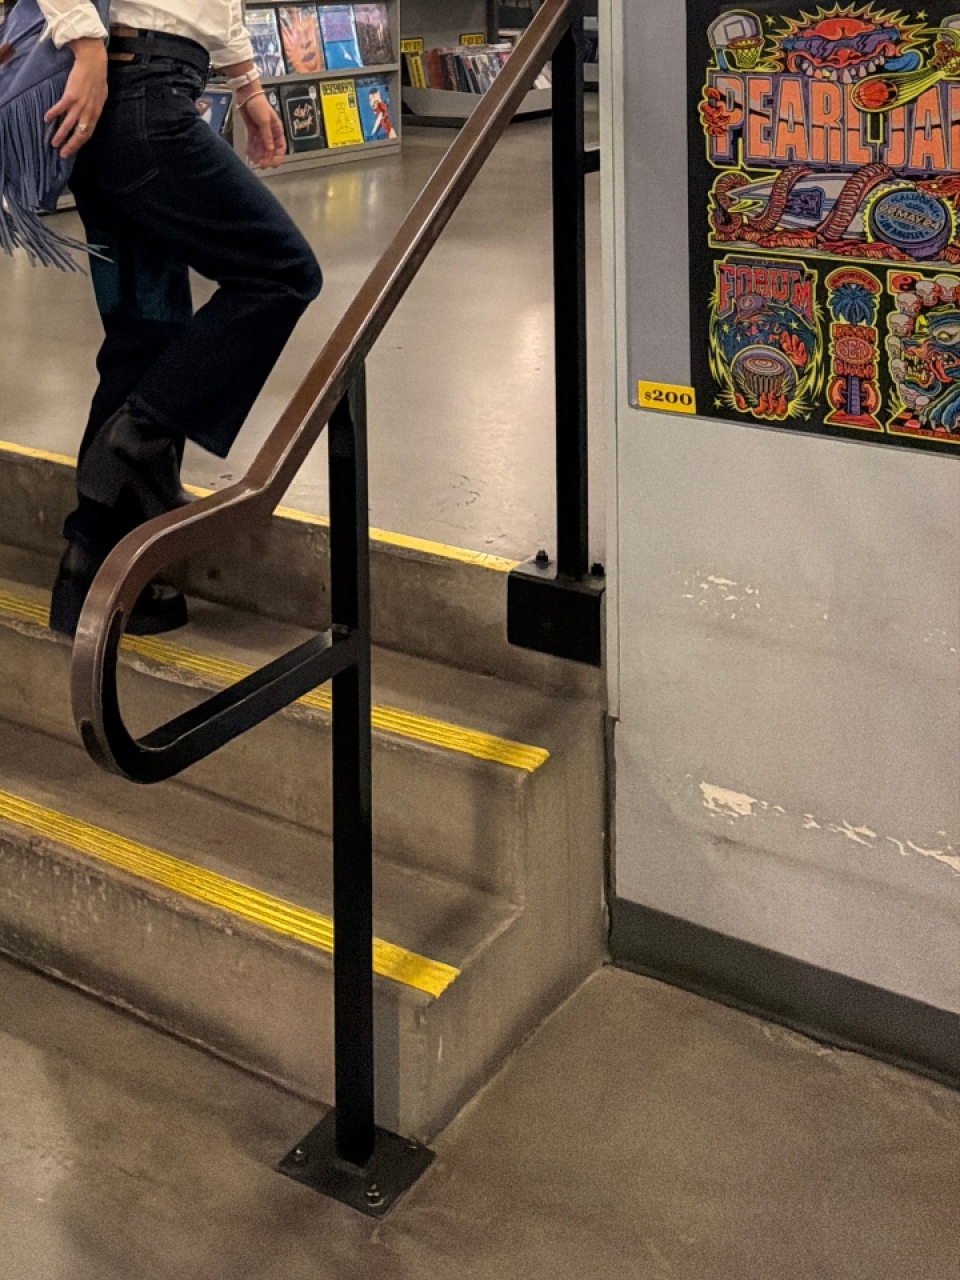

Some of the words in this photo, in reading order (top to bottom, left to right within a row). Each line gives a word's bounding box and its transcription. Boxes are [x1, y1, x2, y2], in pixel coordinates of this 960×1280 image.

[710, 74, 873, 165] PEARL
[718, 263, 813, 325] FORUM
[644, 389, 692, 406] $200
